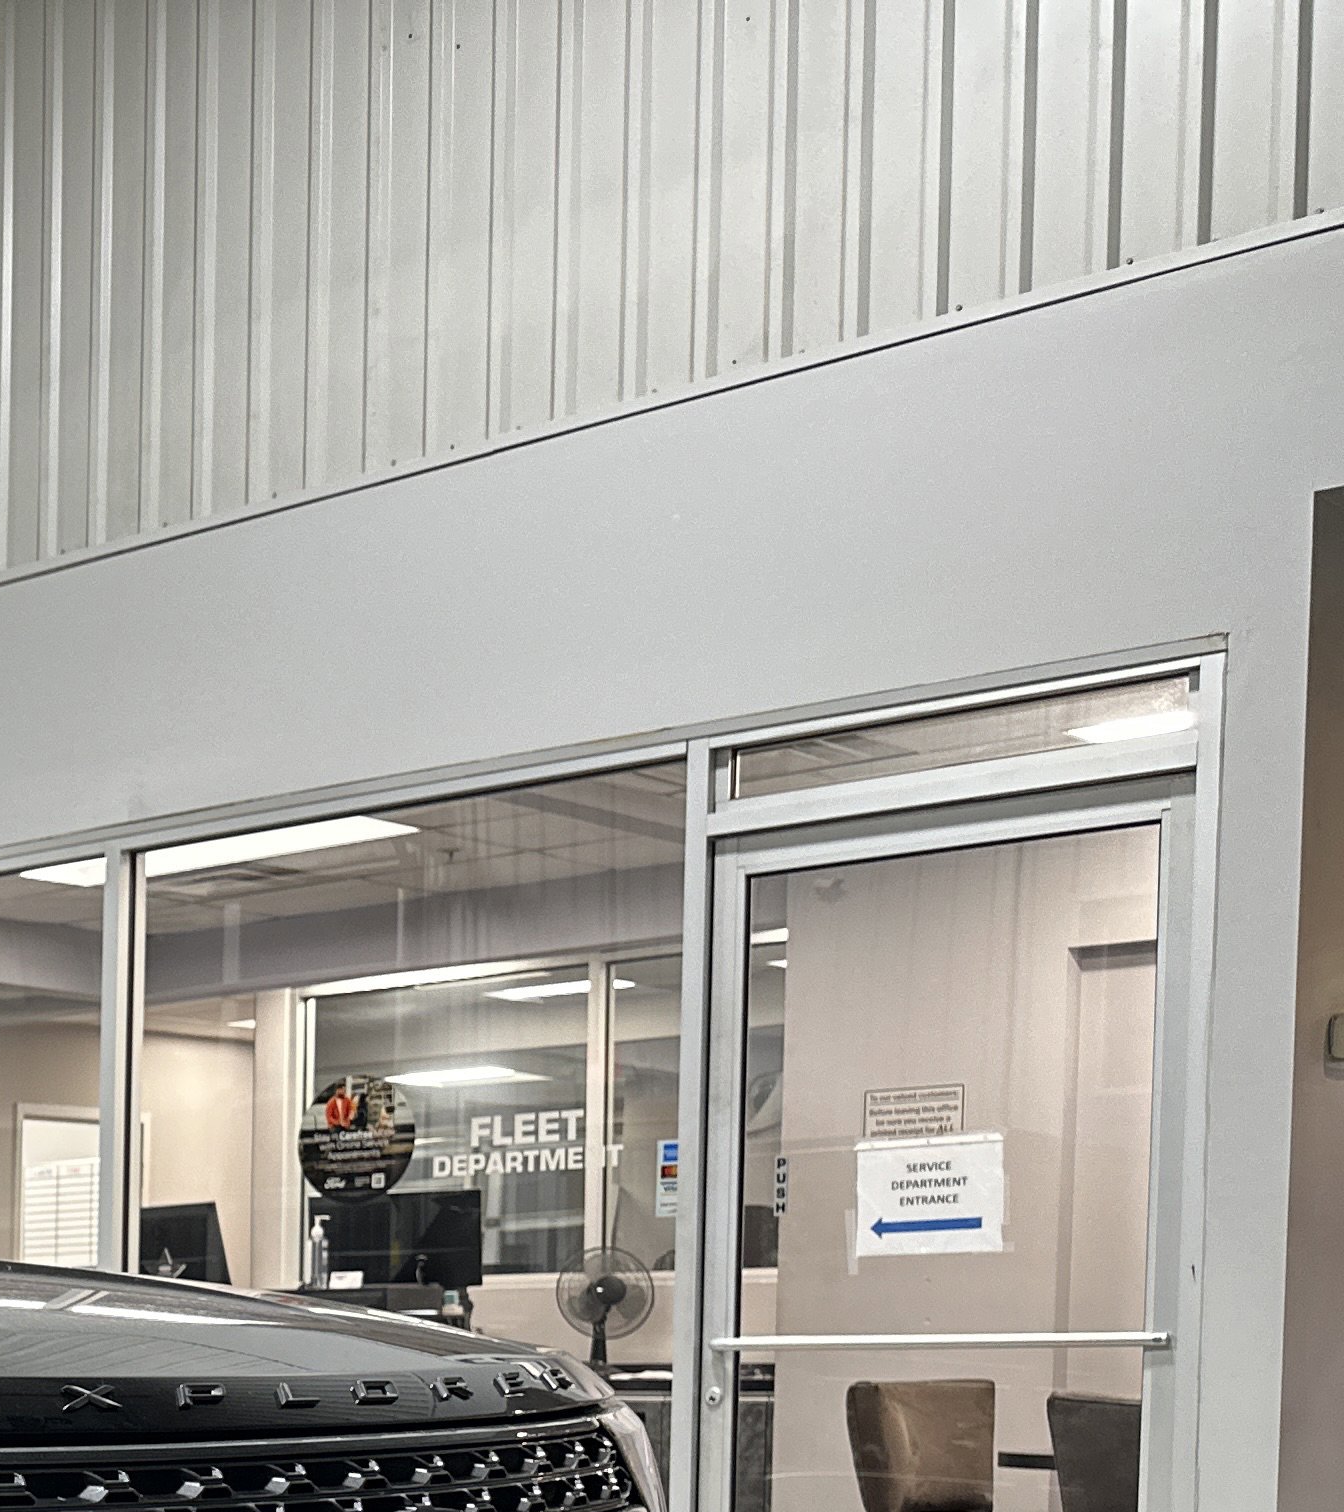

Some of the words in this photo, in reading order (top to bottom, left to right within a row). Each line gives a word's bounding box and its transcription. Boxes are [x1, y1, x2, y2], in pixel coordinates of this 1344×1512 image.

[470, 1108, 585, 1147] FLEET
[432, 1143, 625, 1179] DEPARTMET
[906, 1160, 952, 1174] SERVICE
[776, 1158, 787, 1213] PUSH
[891, 1175, 968, 1191] DEPARTMENT
[899, 1193, 959, 1207] ENTRANCE
